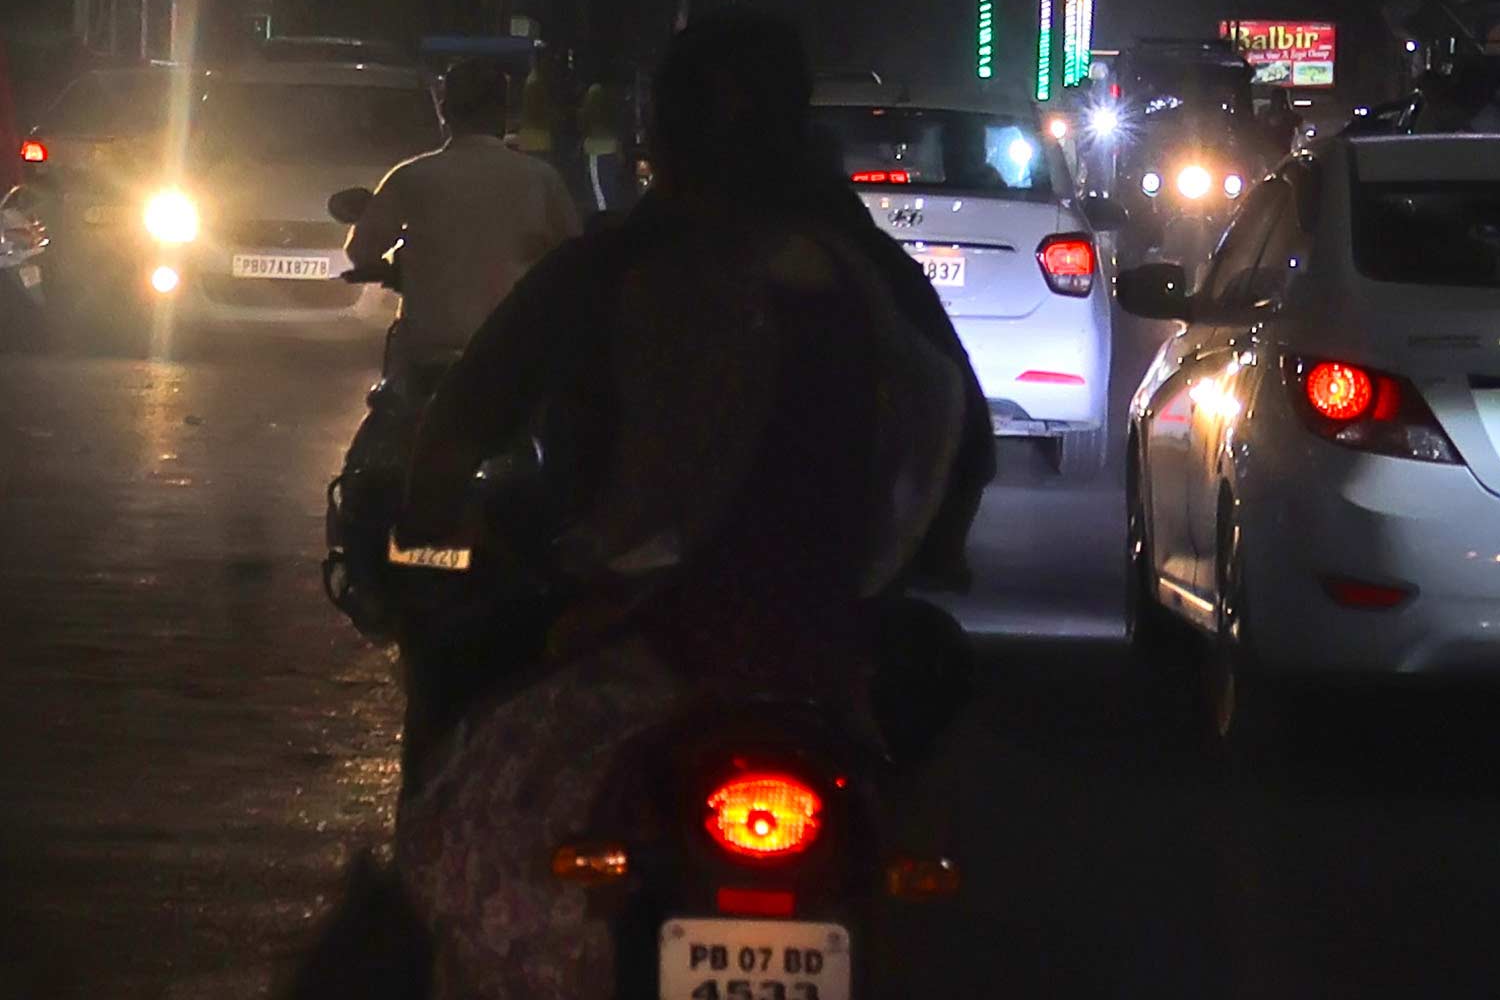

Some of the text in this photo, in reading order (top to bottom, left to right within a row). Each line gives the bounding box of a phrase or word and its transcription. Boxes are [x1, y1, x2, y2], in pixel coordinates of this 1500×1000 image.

[1230, 25, 1319, 49] Balbir
[689, 944, 728, 970] PB
[738, 946, 772, 972] 07
